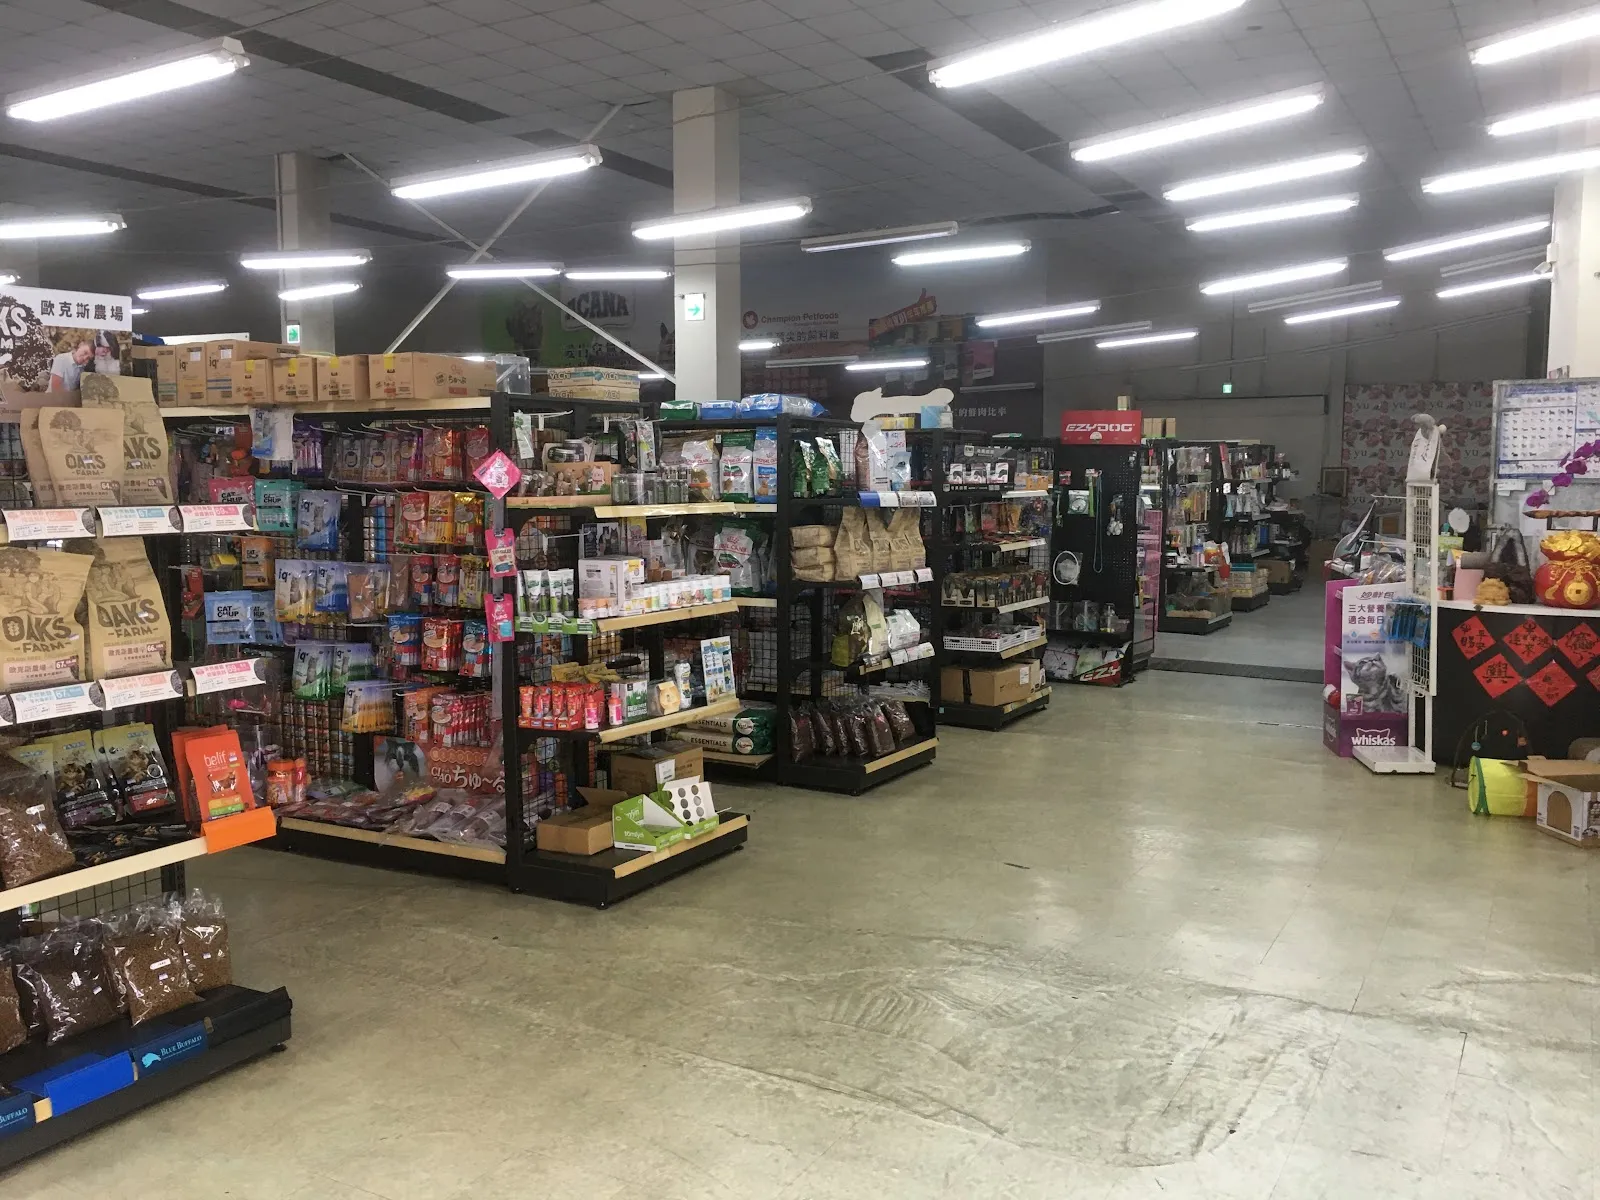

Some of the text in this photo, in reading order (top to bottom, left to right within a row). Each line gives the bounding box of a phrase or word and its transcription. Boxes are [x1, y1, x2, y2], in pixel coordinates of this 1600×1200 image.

[40, 299, 124, 322] 歐克斯農場
[0, 305, 28, 337] K'S
[760, 314, 800, 324] Champion
[803, 311, 839, 321] Petfoods
[954, 406, 1007, 417] 的鮮肉比率
[1065, 423, 1134, 432] EZYDOG
[123, 436, 161, 460] AK'S
[221, 491, 236, 499] CAT
[1348, 604, 1385, 613] 三大營養
[690, 737, 727, 747] ESSENTIALS
[1351, 734, 1396, 746] whiskas
[203, 751, 227, 767] belif
[160, 1035, 202, 1056] BLUE BUFFALO
